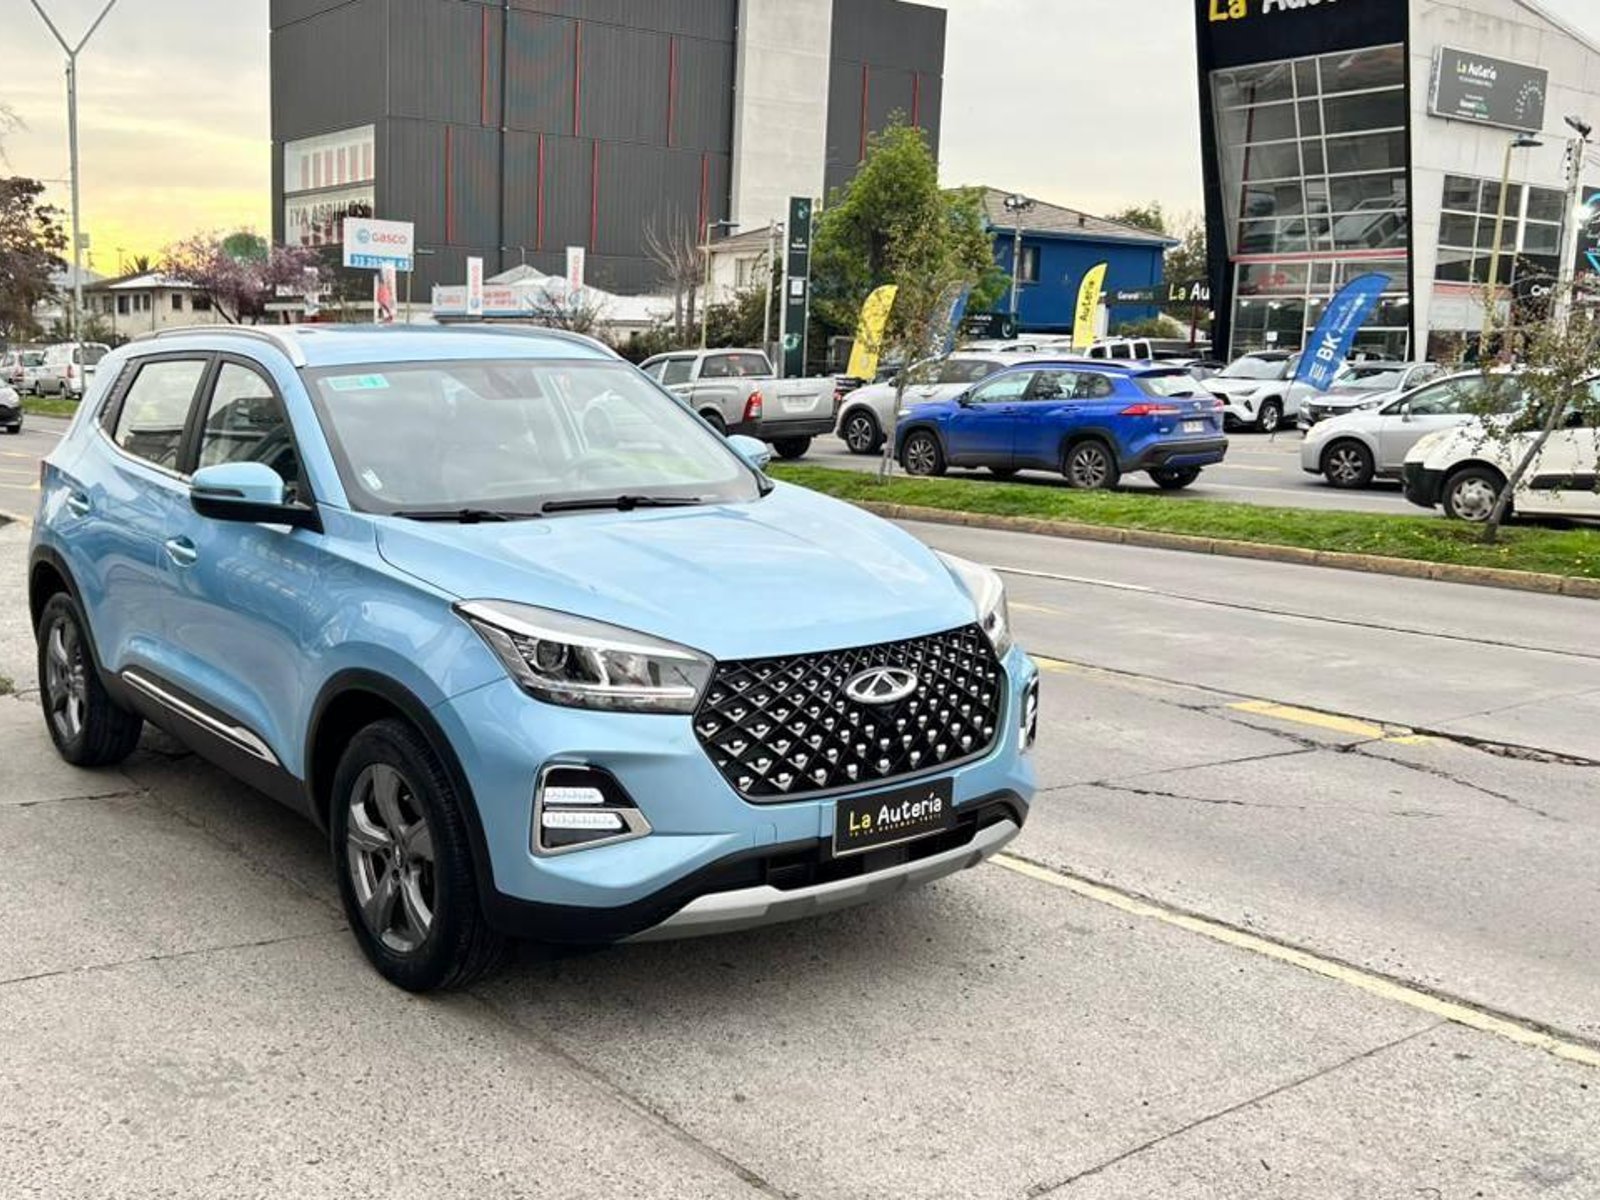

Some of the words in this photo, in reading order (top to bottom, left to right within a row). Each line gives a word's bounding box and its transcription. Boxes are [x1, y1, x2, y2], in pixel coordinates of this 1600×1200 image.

[1208, 0, 1248, 22] La
[1456, 60, 1467, 74] La
[1168, 282, 1187, 301] La
[1316, 331, 1343, 361] BK
[849, 810, 872, 831] La
[876, 791, 943, 826] Autería
